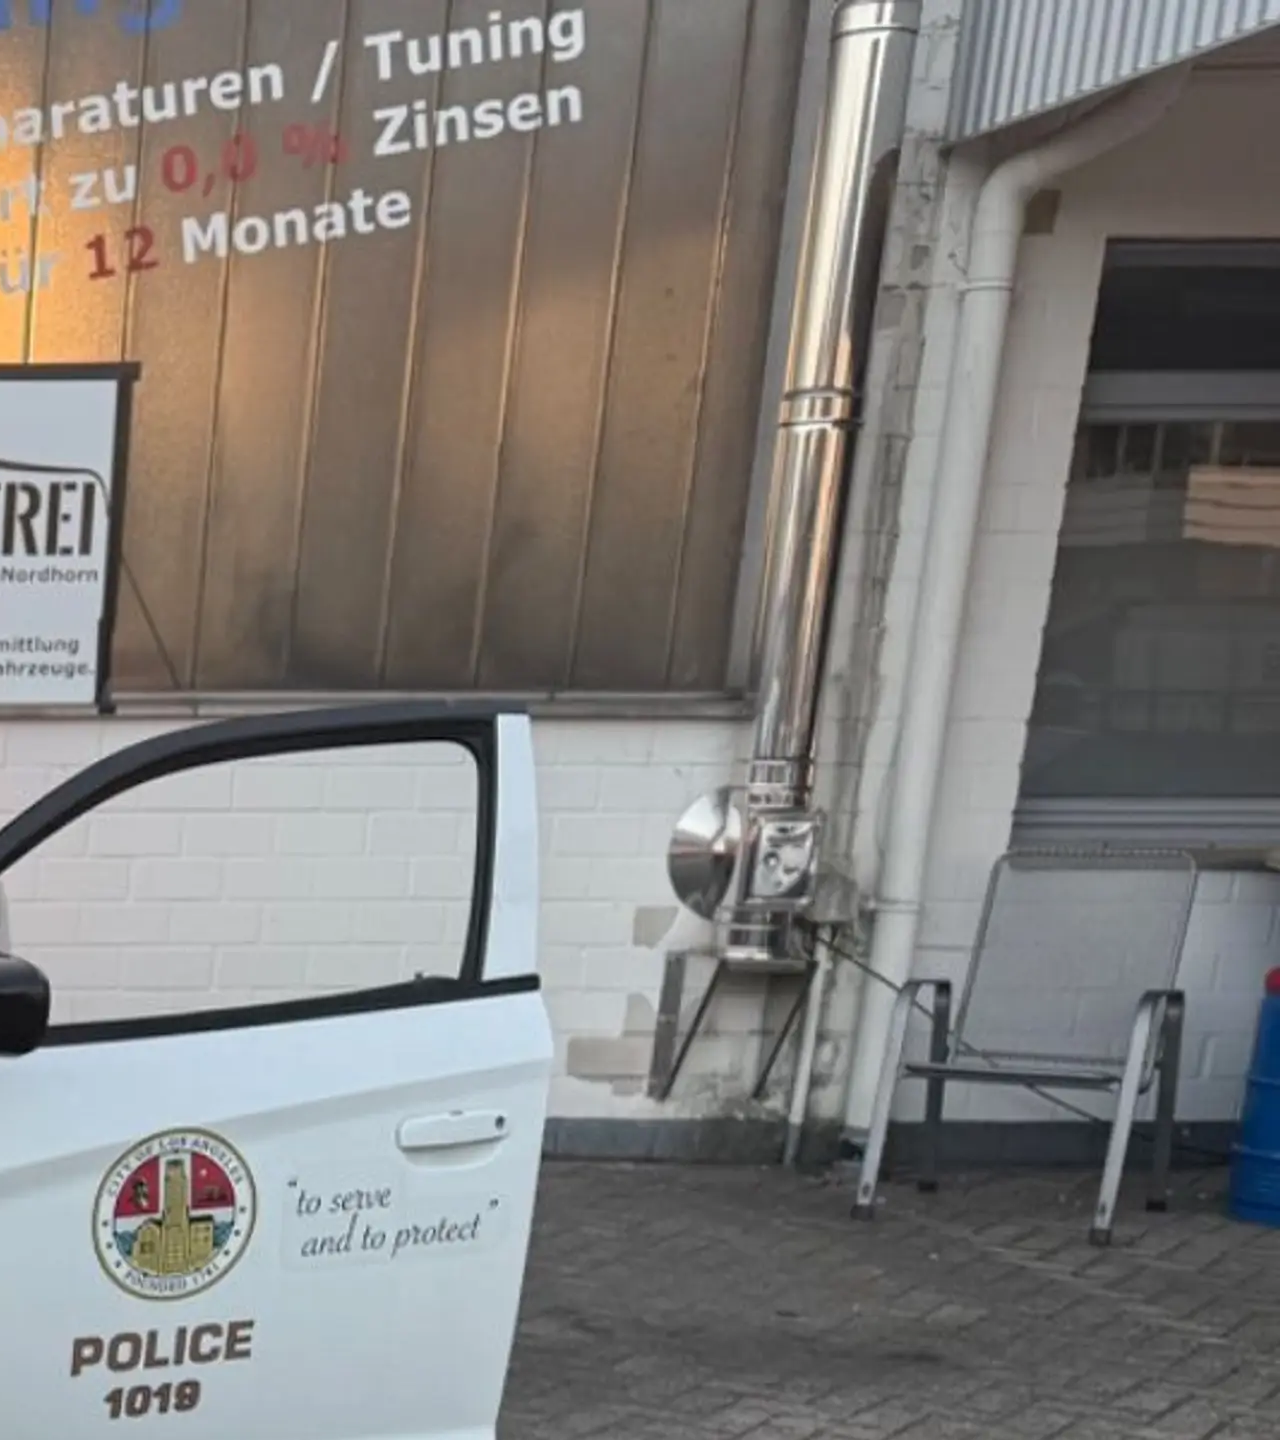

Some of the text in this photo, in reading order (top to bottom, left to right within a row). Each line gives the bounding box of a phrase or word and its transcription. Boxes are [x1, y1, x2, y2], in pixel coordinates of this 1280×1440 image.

[311, 39, 339, 102] /
[364, 8, 585, 81] Tuning
[68, 165, 136, 210] zu
[161, 130, 258, 197] 0,0
[373, 84, 582, 157] Zinsen
[84, 225, 159, 280] 12
[181, 187, 411, 263] Monate
[1, 566, 98, 584] Nordhorn
[328, 1187, 391, 1214] serve
[301, 1212, 358, 1257] and
[361, 1223, 386, 1251] to
[71, 1320, 254, 1376] POLICE
